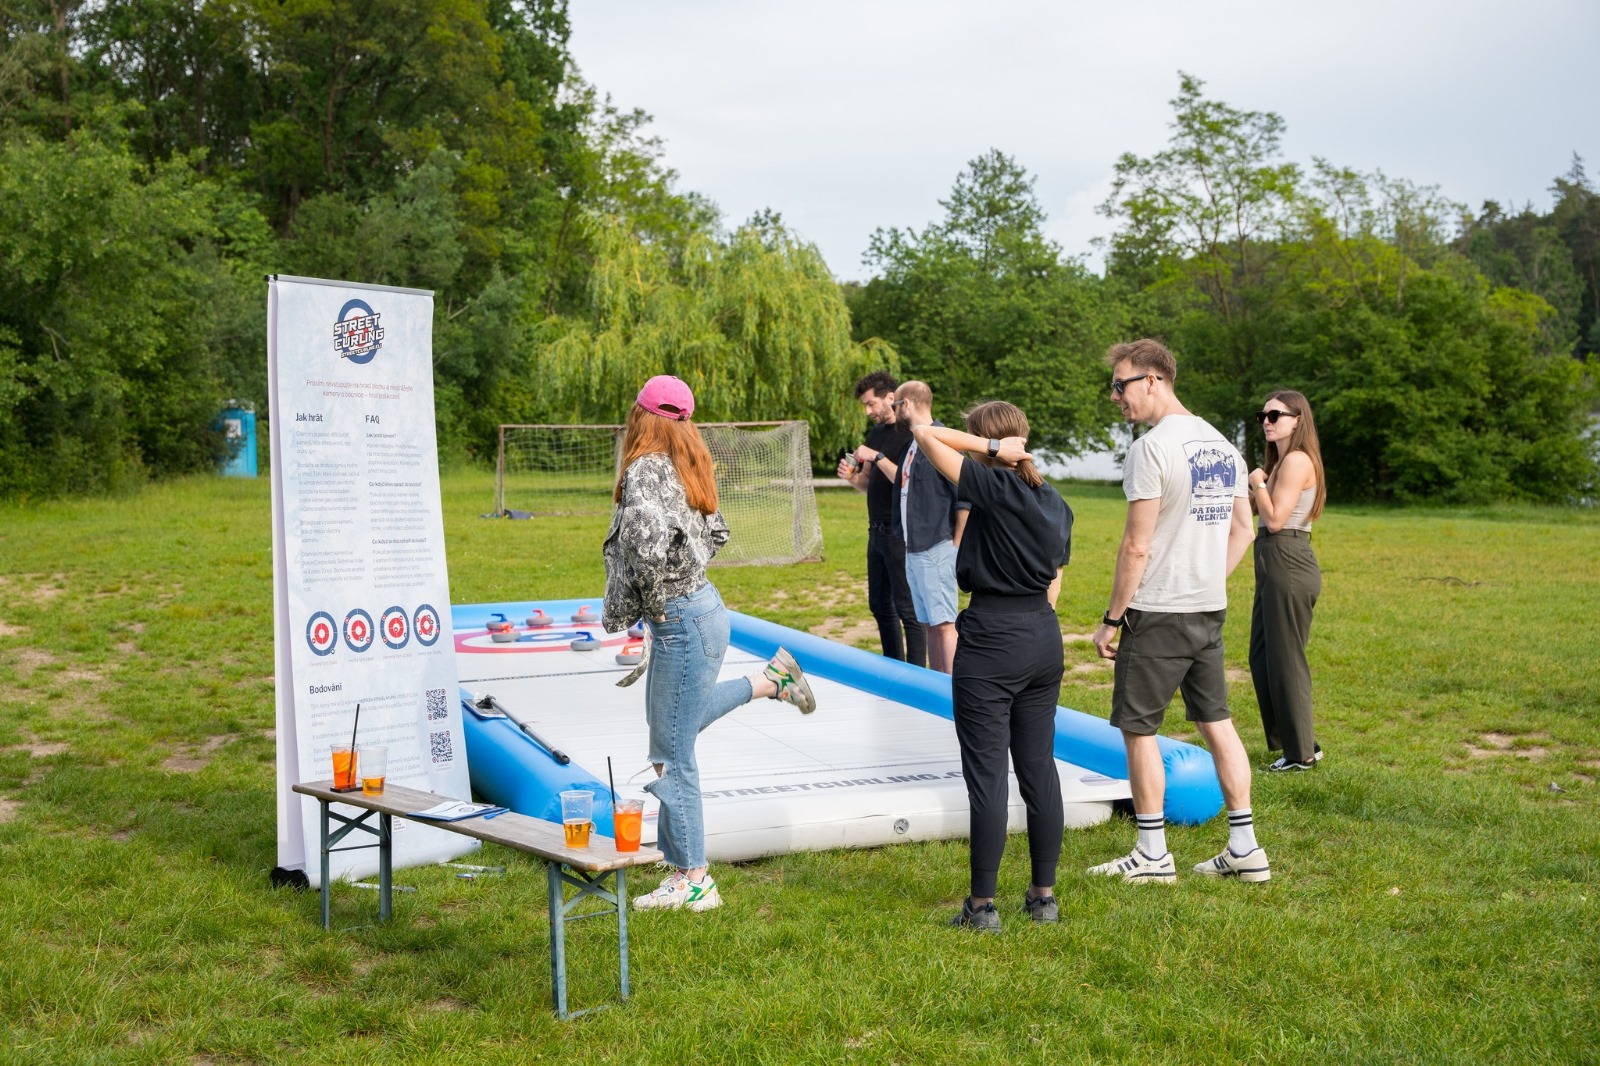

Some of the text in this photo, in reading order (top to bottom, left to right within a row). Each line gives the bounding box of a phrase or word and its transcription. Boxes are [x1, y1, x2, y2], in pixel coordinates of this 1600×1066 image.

[333, 313, 380, 336] STREET
[333, 328, 384, 351] CURLING
[295, 412, 323, 422] Jak hrát
[365, 414, 380, 424] FAQ
[309, 682, 343, 695] Bodování
[700, 771, 963, 799] STREETCURLING.C
